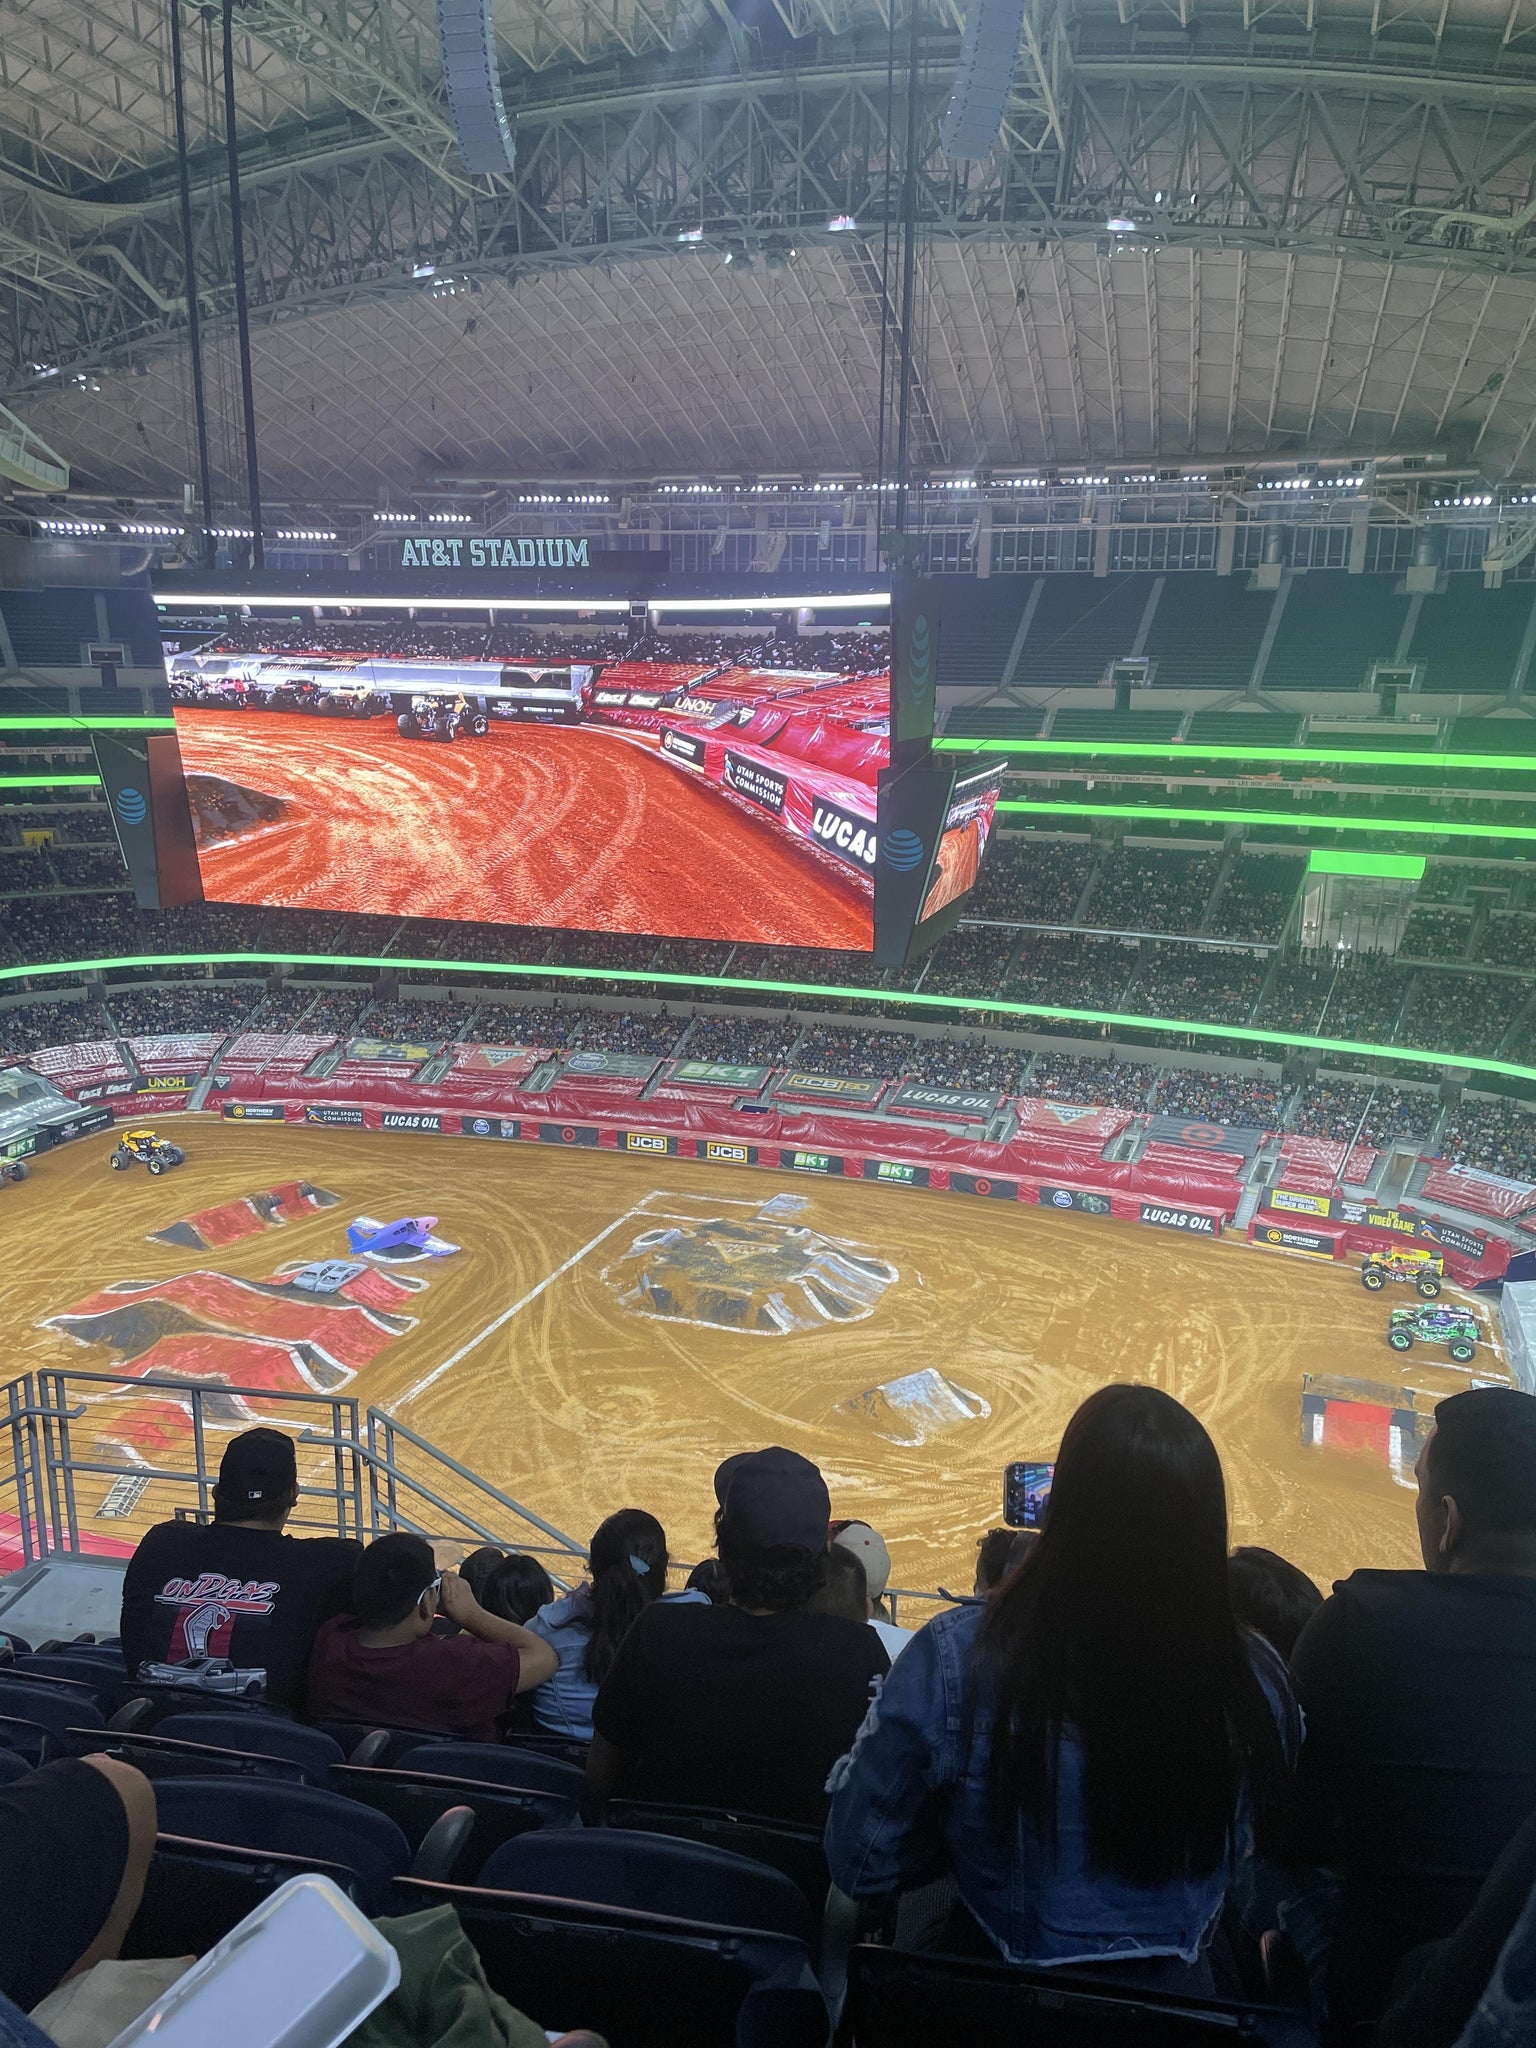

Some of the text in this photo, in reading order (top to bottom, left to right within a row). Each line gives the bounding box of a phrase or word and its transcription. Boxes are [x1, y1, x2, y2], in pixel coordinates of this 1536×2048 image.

[401, 539, 590, 567] AT&T STADIUM
[674, 697, 716, 714] UNOH
[736, 764, 784, 795] UTAH SPORTS
[735, 775, 782, 807] COMMISSION
[679, 1062, 759, 1079] BKT
[147, 1077, 186, 1088] UNOH
[793, 1077, 840, 1089] JCB
[902, 1090, 961, 1105] LUCAS
[384, 1115, 420, 1128] LUCAS
[7, 1139, 36, 1157] BKT
[630, 1136, 664, 1150] JCB
[710, 1146, 745, 1160] JCB
[794, 1153, 829, 1167] BKT
[878, 1163, 914, 1177] BKT
[1276, 1193, 1289, 1201] THE
[1142, 1208, 1188, 1227] LUCAS
[1387, 1210, 1400, 1219] THE
[1368, 1214, 1392, 1228] VIDEO
[1392, 1218, 1415, 1233] GAME
[1282, 1233, 1320, 1245] NORTHERN
[1440, 1235, 1483, 1256] COMMISSION
[1442, 1229, 1485, 1250] UTAH SPORTS
